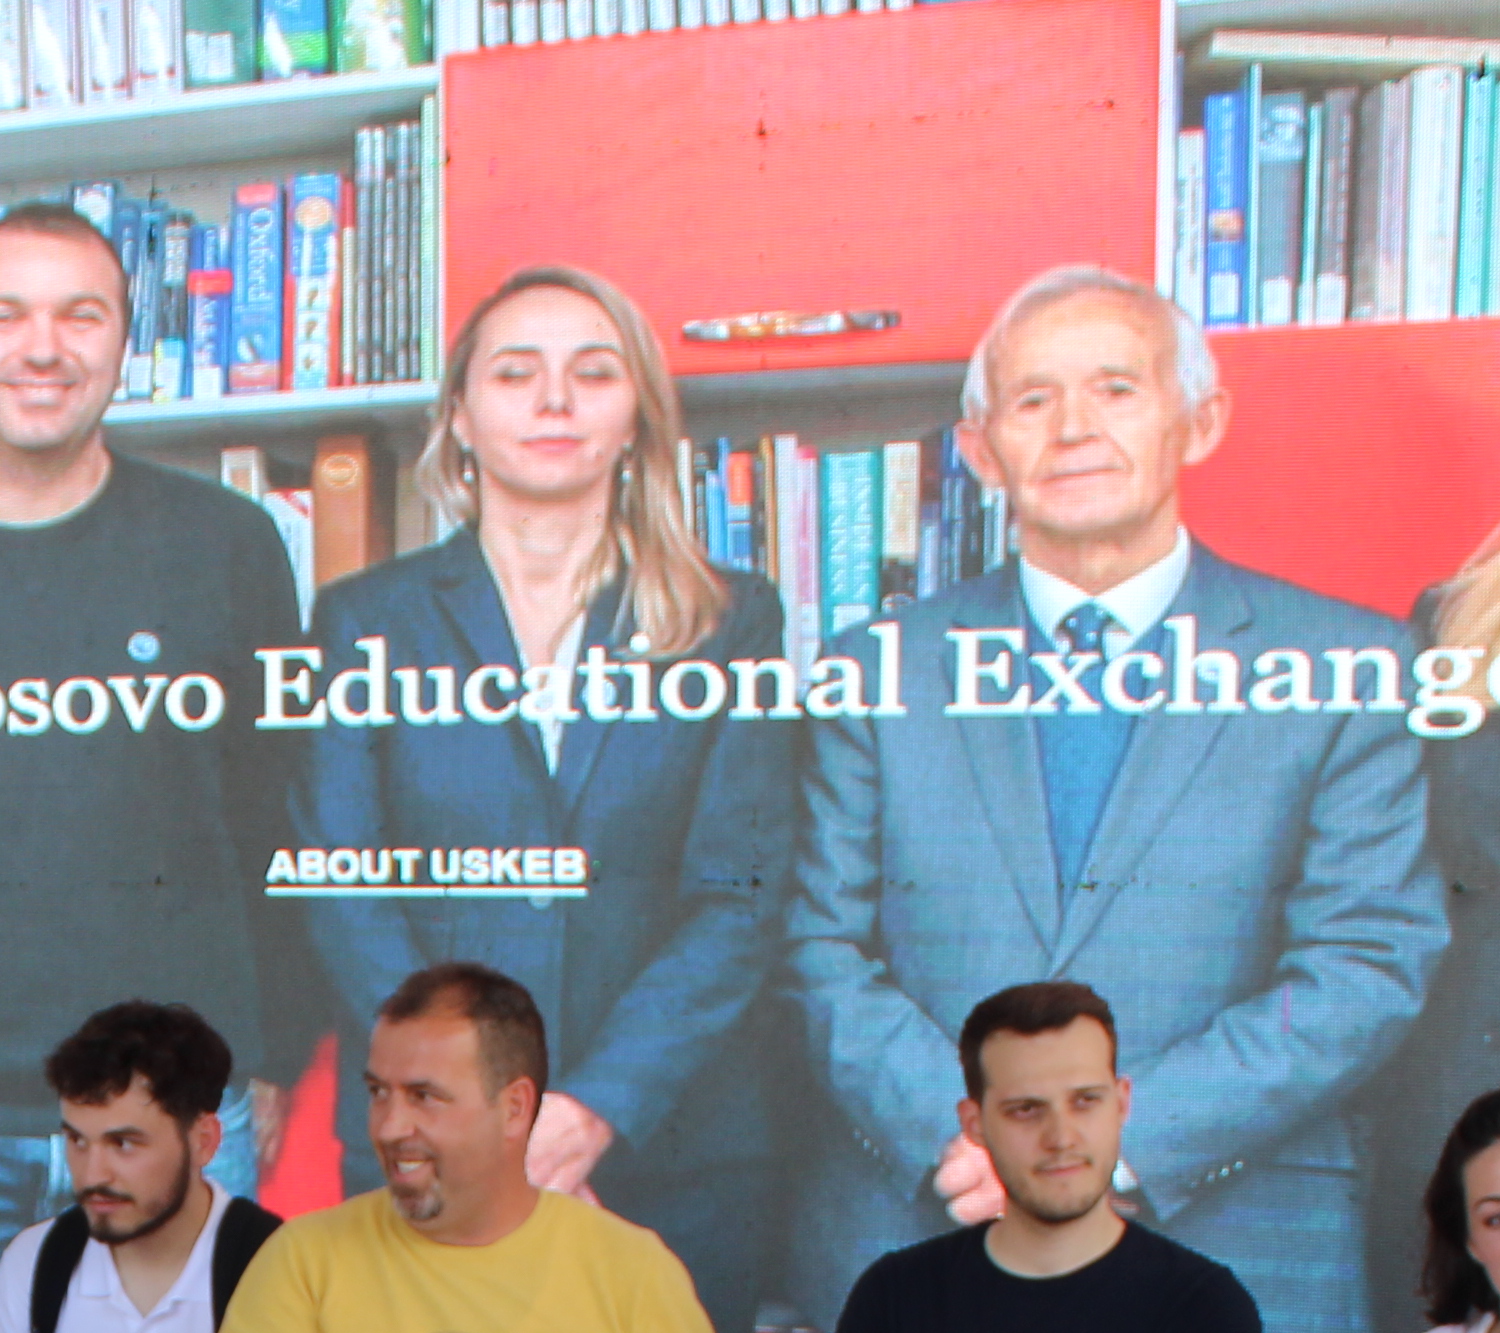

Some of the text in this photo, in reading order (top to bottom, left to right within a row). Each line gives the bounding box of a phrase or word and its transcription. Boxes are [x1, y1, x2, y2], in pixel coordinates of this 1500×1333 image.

[254, 620, 906, 730] Educational
[265, 847, 588, 886] ABOUT USKEB
